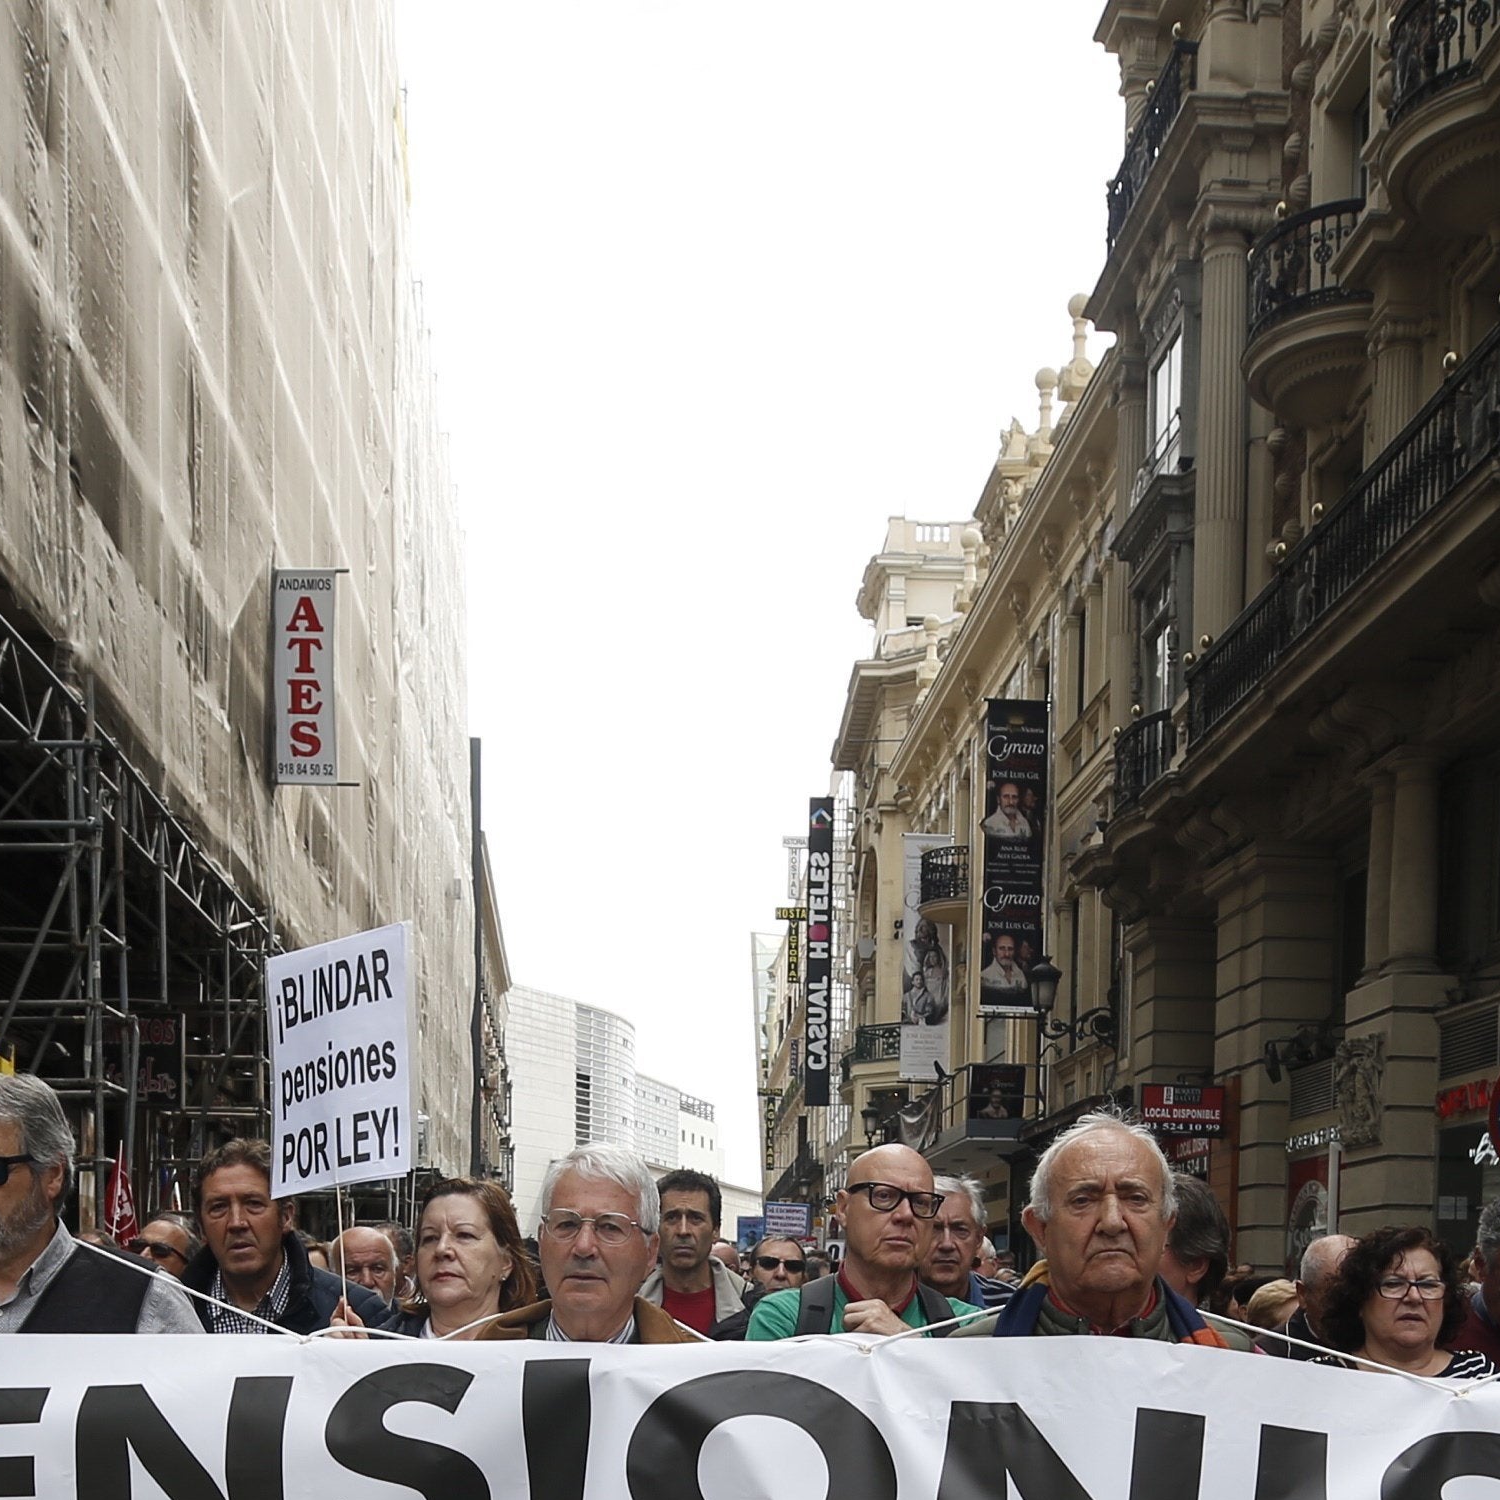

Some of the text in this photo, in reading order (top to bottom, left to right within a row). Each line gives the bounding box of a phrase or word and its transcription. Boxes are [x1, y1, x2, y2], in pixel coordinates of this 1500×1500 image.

[278, 578, 332, 591] ANDAMIOS
[285, 596, 324, 758] ATES
[987, 734, 1045, 762] Cyrano
[278, 763, 334, 777] 918 84 50 52
[776, 908, 807, 919] HOSTA
[983, 886, 1040, 912] Cyrano
[789, 921, 798, 977] VICTORIA
[276, 948, 393, 1044] ¡BLINDAR
[807, 974, 829, 1071] CASUAL
[281, 1040, 397, 1121] pensiones
[767, 1102, 775, 1165] AGUILAR
[1144, 1107, 1221, 1120] LOCAL DISPONIBLE
[1162, 1122, 1184, 1131] 524
[1188, 1123, 1202, 1131] 10
[1206, 1124, 1221, 1132] 99
[281, 1106, 399, 1184] POR LEY!
